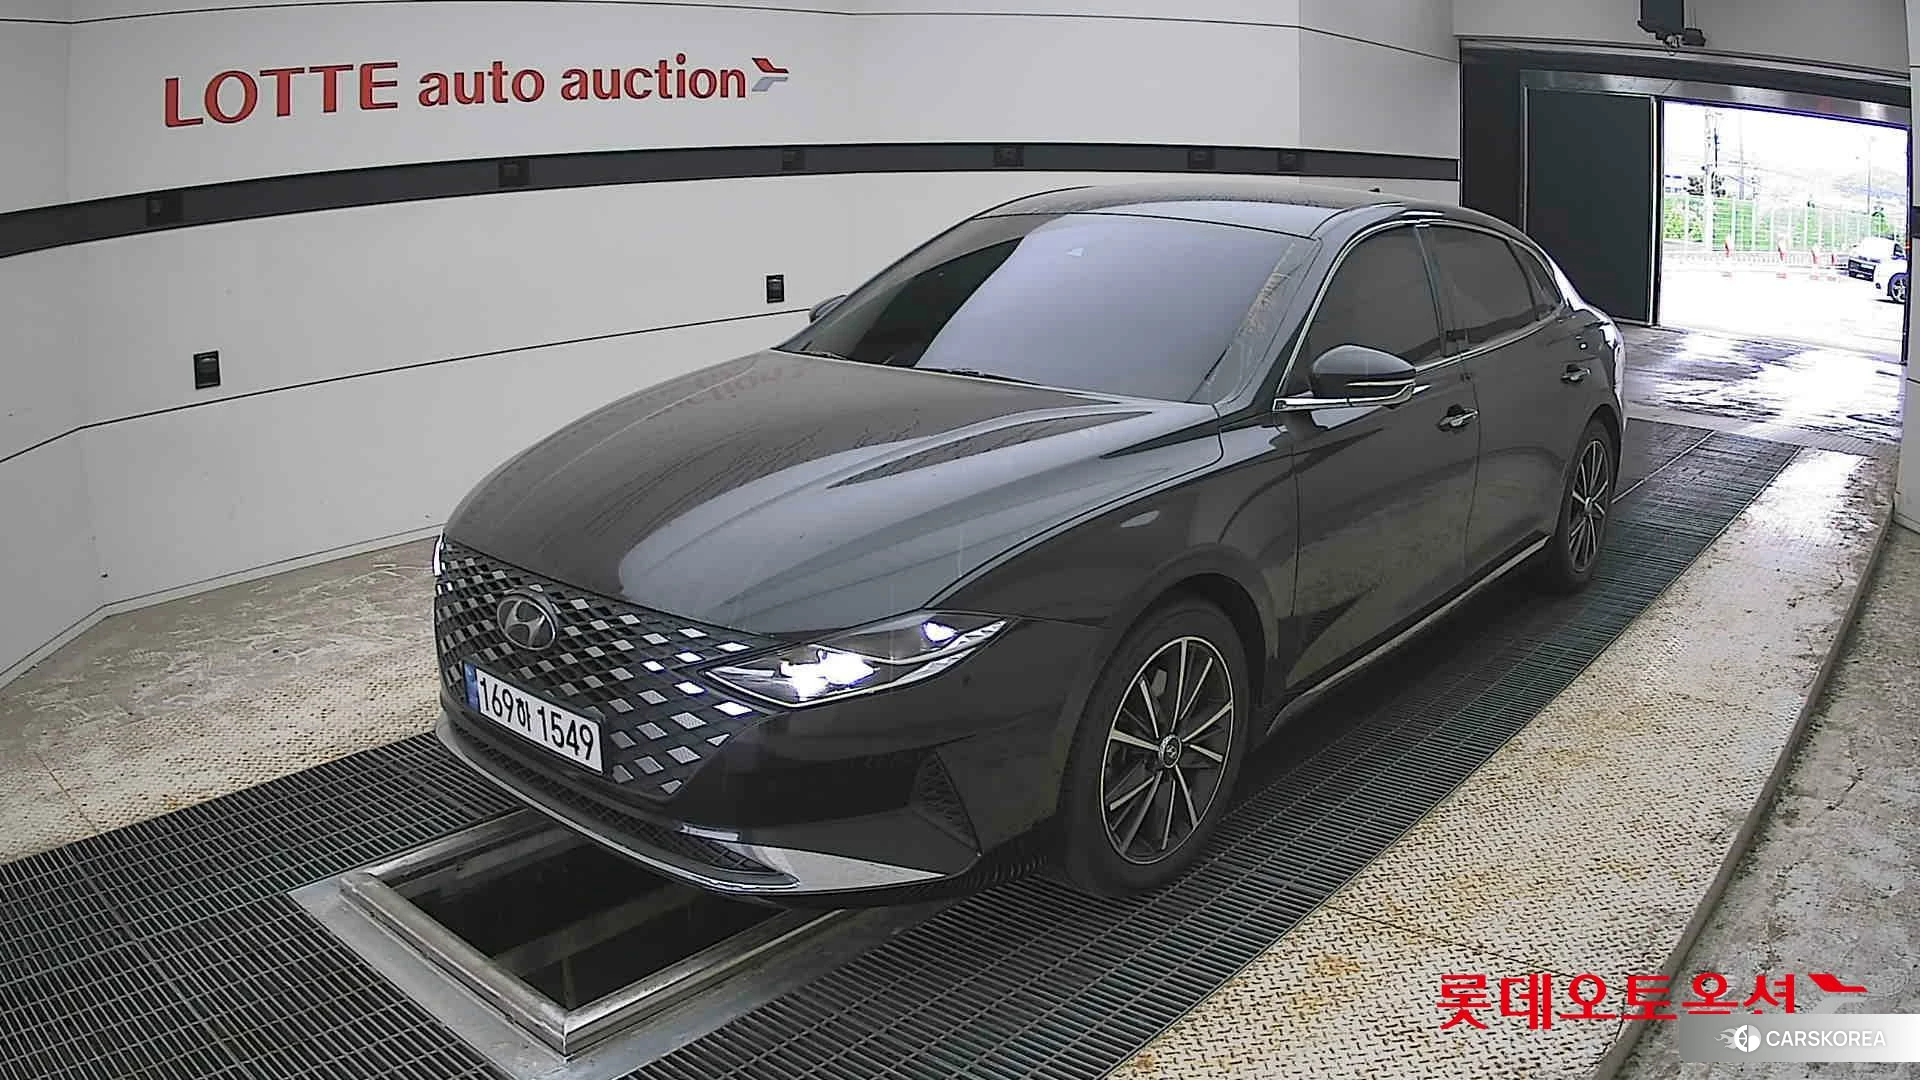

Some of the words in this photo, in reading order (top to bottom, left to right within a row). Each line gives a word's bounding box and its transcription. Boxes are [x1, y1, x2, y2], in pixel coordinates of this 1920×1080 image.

[164, 62, 400, 128] LOTTE
[418, 61, 546, 107] auto
[560, 53, 747, 101] auction
[479, 677, 532, 732] 169하
[537, 706, 595, 761] 1549
